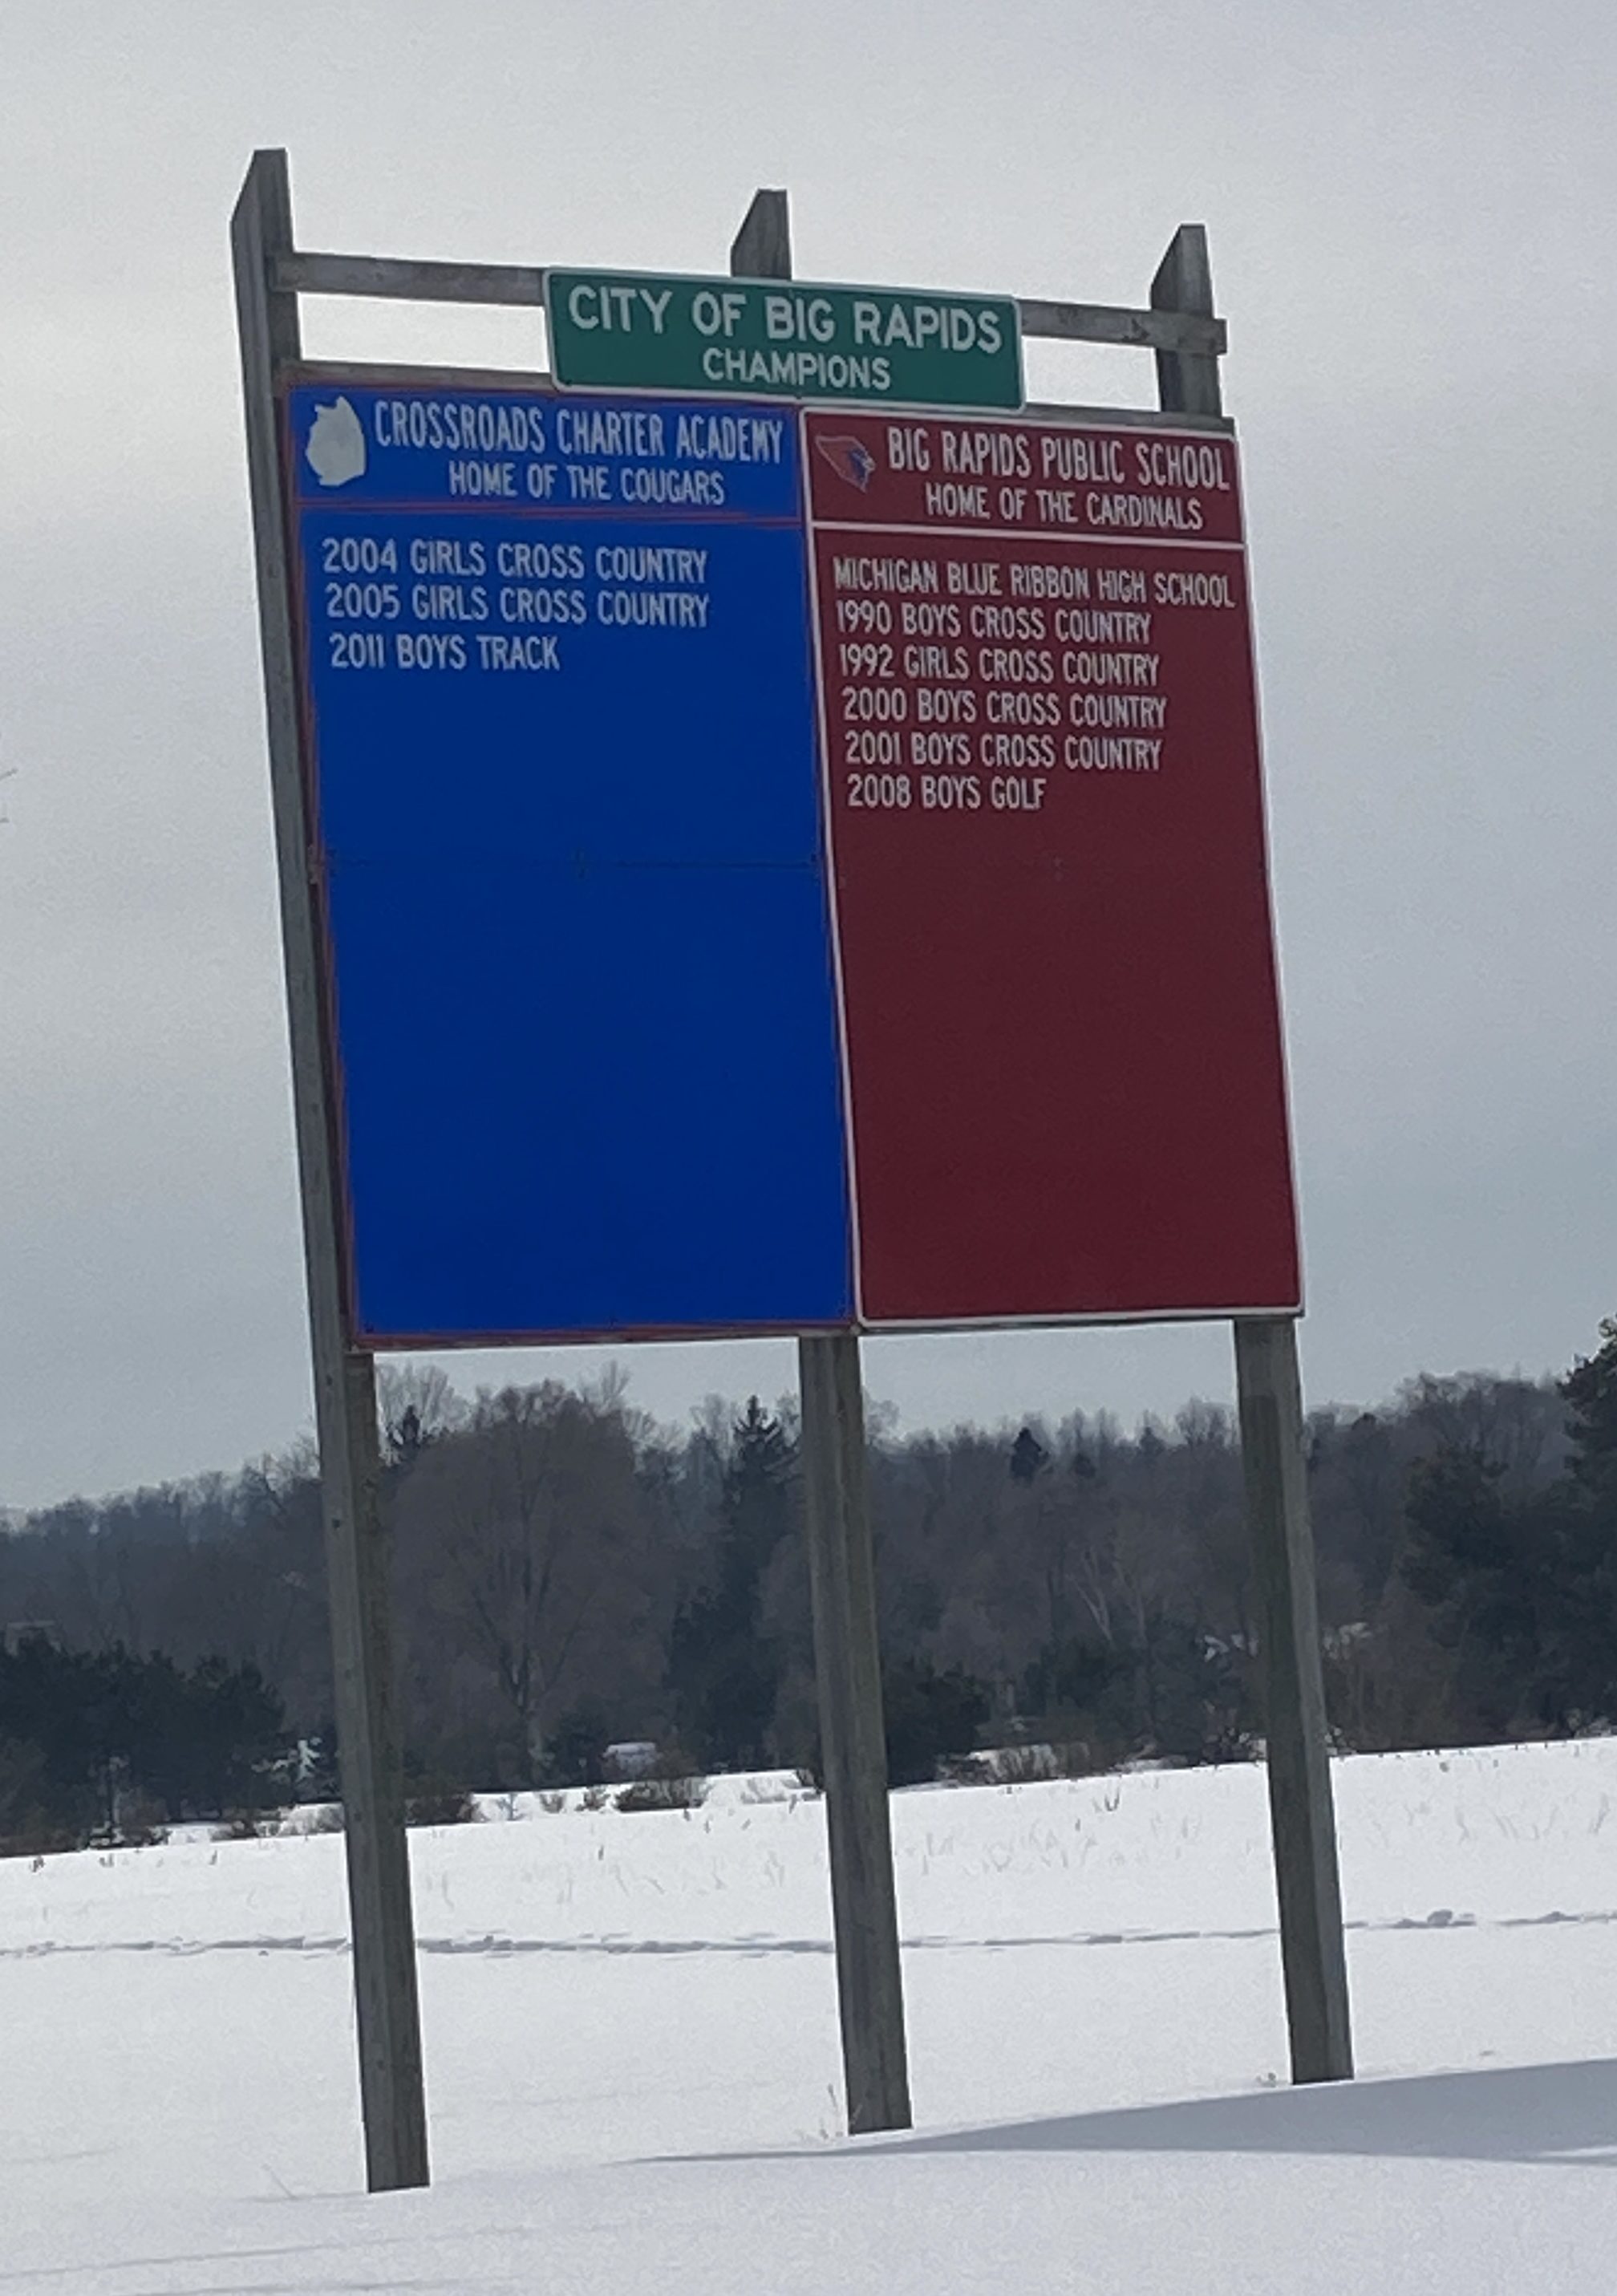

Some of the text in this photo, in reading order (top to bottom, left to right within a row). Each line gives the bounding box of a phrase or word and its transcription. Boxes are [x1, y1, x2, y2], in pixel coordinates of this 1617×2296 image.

[569, 286, 1002, 354] CITY OF BIG RAPIDS
[703, 348, 891, 390] CHAMPIONS
[375, 401, 783, 464] CROSSROADS CHARTER ACADEMY
[888, 427, 1230, 491] BIG RAPIDS PUBLIC SCHOOL
[449, 461, 724, 505] HOME OF THE COUGARS
[926, 483, 1202, 530] HOME OF THE CARDINALS
[322, 538, 707, 583] 2004 GIRLS CROSS COUNTRY
[833, 558, 1235, 607] MICHIGAN BLUE RIBBON HIGH SCHOOL
[325, 583, 710, 628] 2005 GIRLS CROSS COUNTRY
[836, 600, 1152, 643] 1990 BOYS CROSS COUNTRY
[329, 632, 560, 671] 2011 BOYS TRACK
[839, 644, 1159, 687] 1992 GIRLS CROSS COUNTRY
[841, 687, 1167, 729] 2000 BOYS CROSS COUNTRY
[845, 731, 1162, 771] 2001 BOYS CROSS COUNTRY
[847, 774, 1046, 810] 2008 BOYS GOLF
